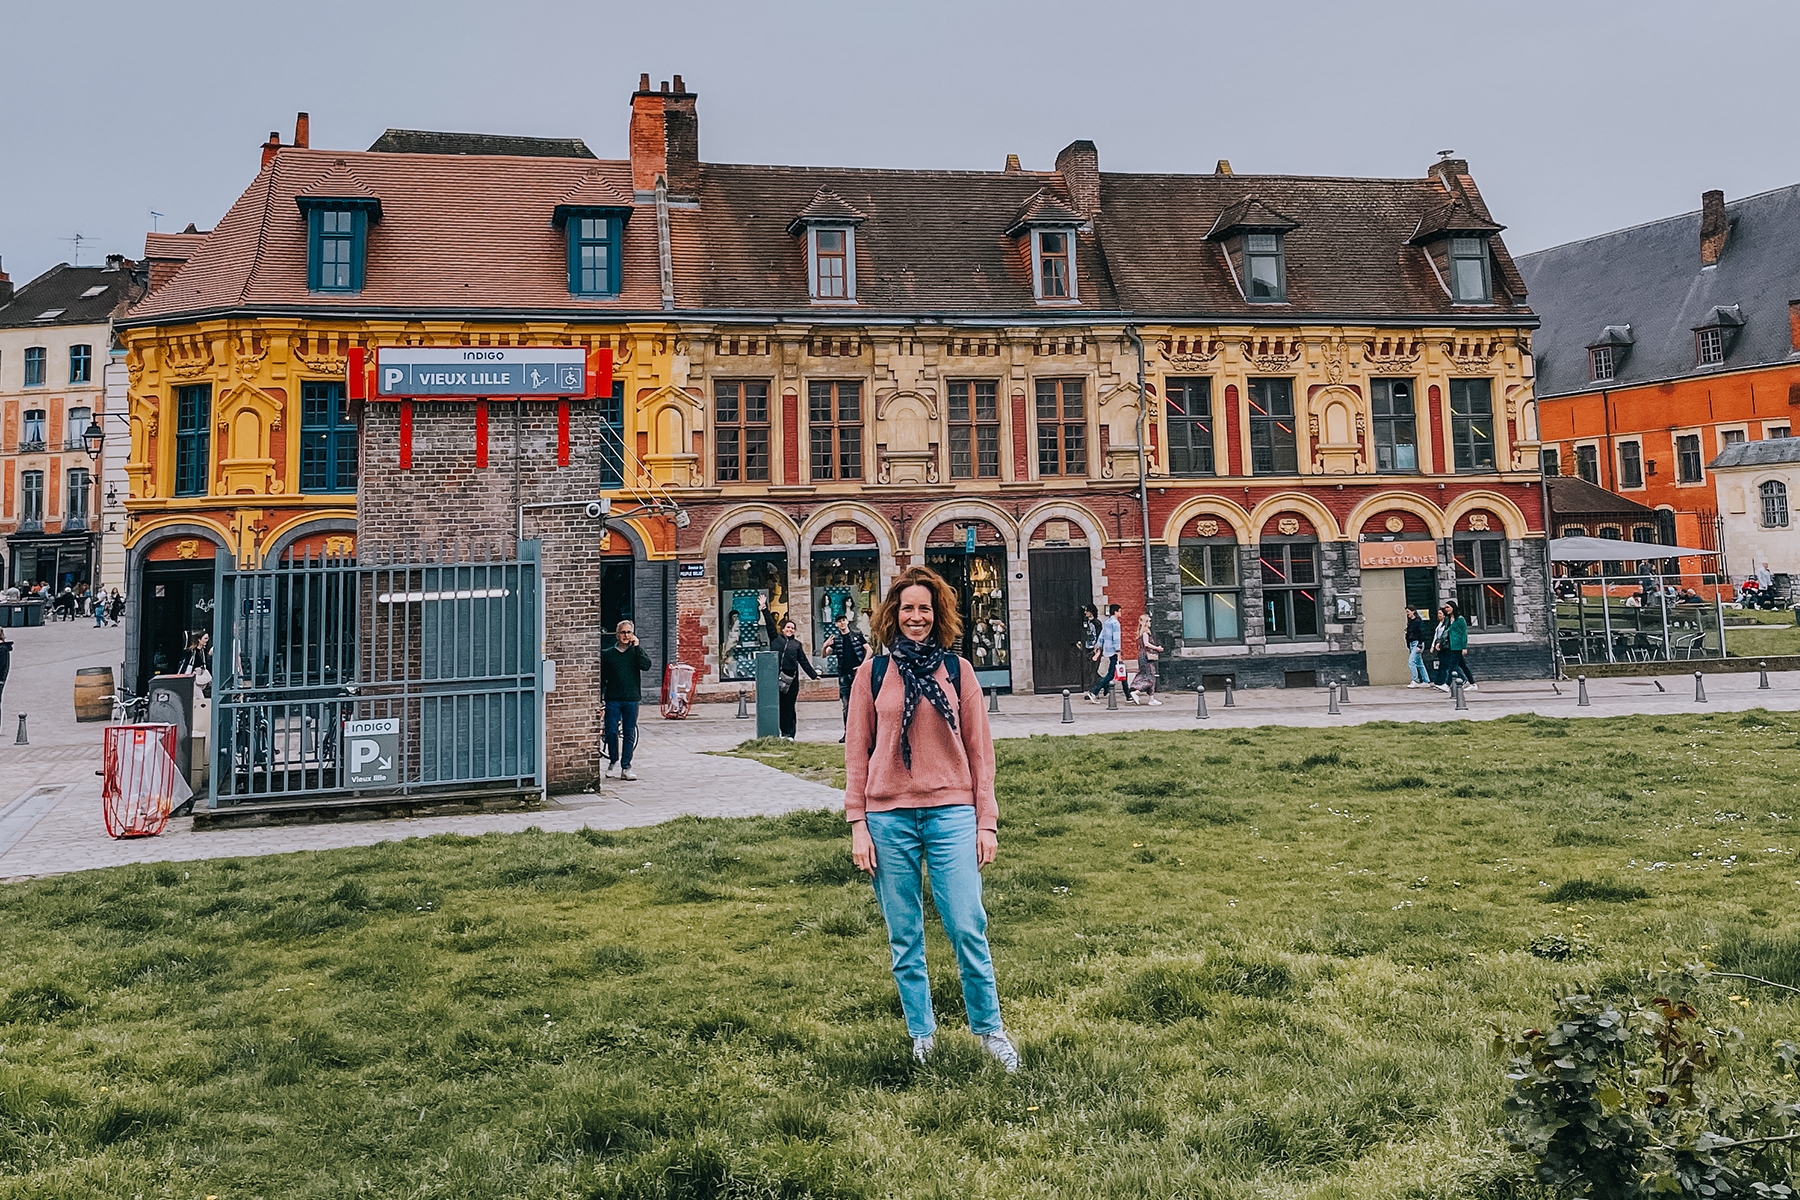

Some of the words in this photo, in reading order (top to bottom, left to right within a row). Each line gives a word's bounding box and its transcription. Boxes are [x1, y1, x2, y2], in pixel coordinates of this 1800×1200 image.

[463, 351, 504, 361] INDIGO
[384, 368, 404, 391] P
[419, 373, 466, 385] VIEUX
[471, 373, 510, 385] LILLE
[1363, 557, 1376, 565] LE
[352, 722, 392, 732] INDIGO
[351, 739, 380, 773] P
